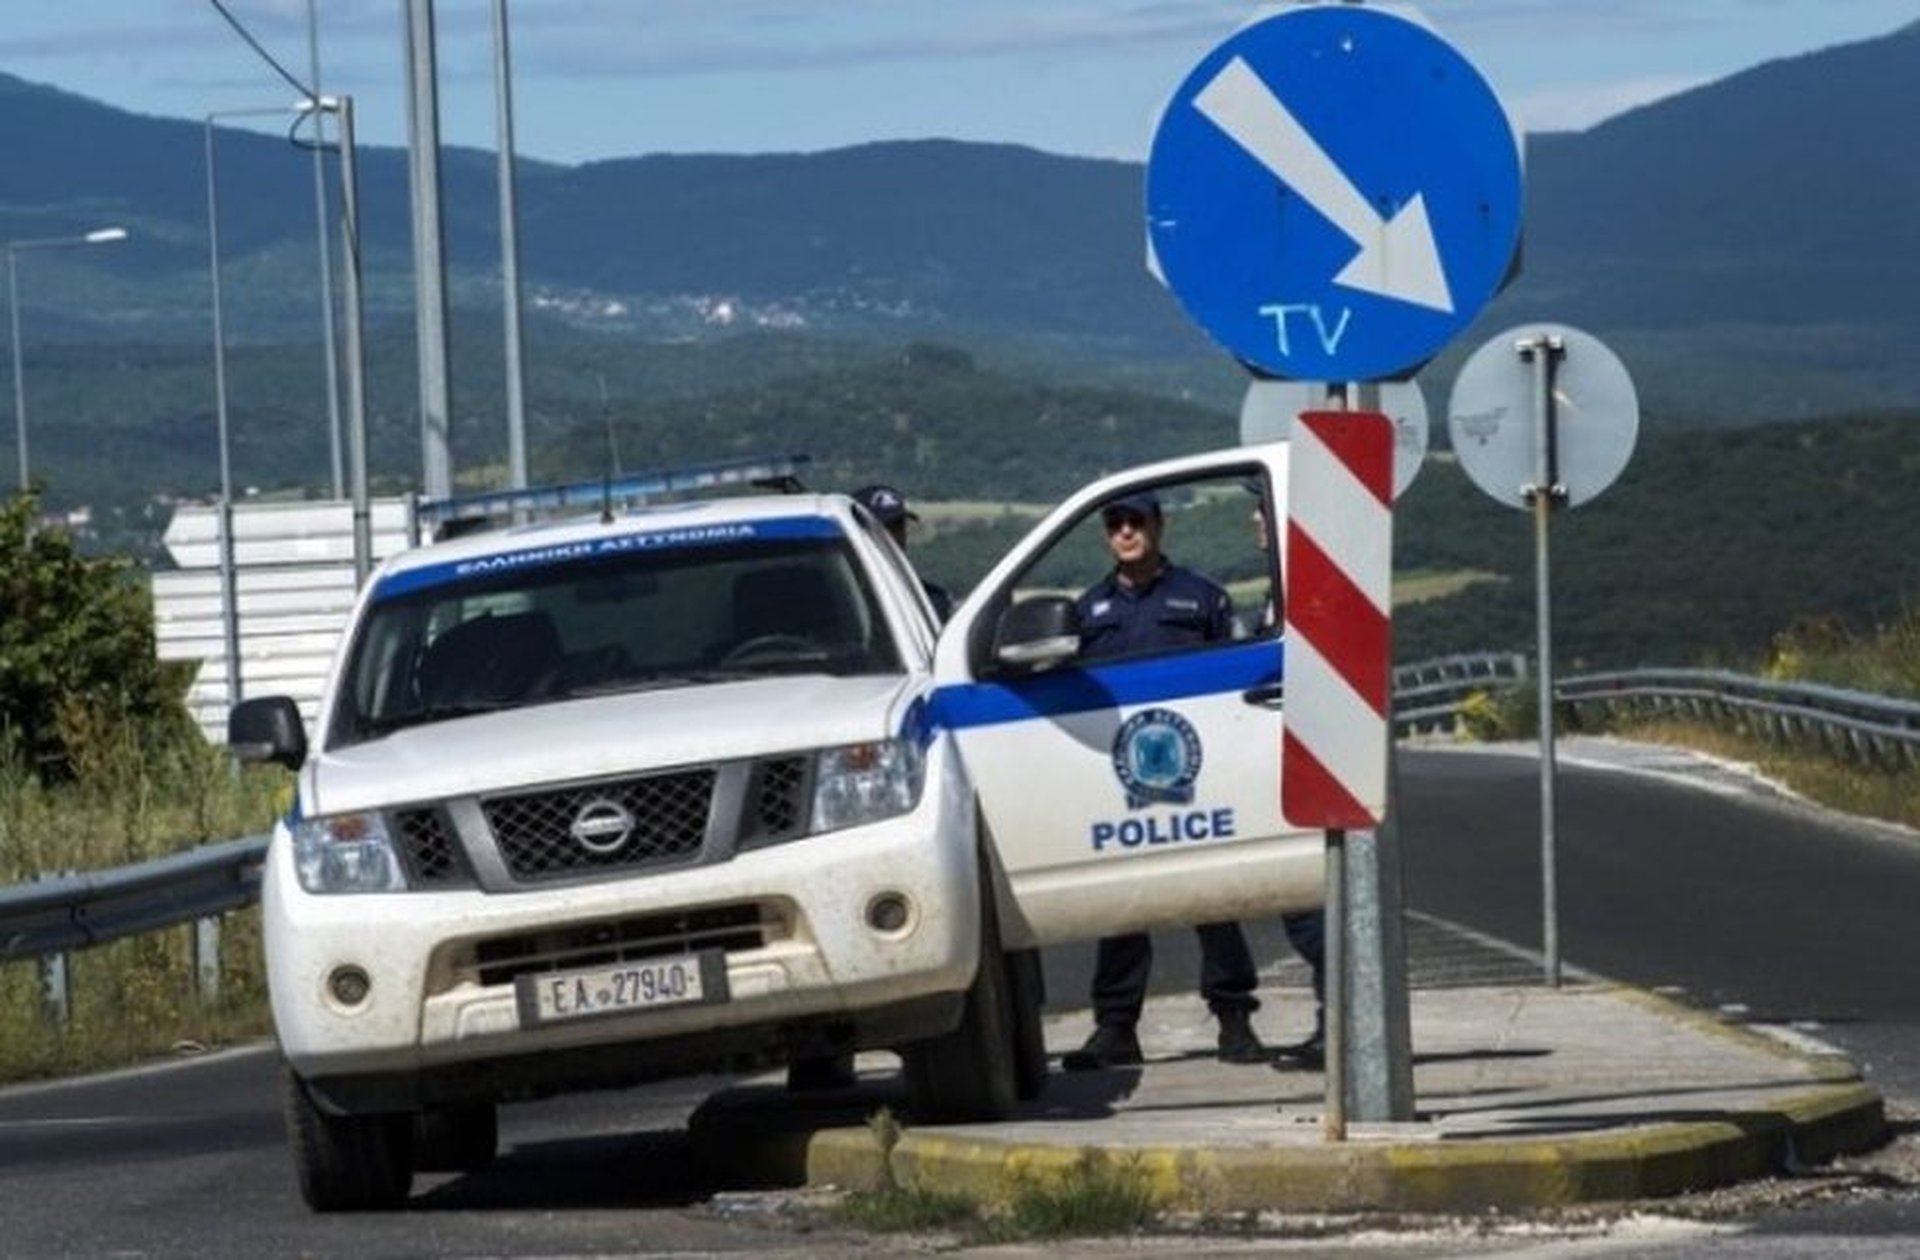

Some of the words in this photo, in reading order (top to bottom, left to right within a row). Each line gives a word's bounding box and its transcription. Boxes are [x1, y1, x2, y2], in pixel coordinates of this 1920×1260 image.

[1259, 303, 1351, 357] TV
[1091, 808, 1235, 851] POLICE
[612, 964, 687, 1005] 27940
